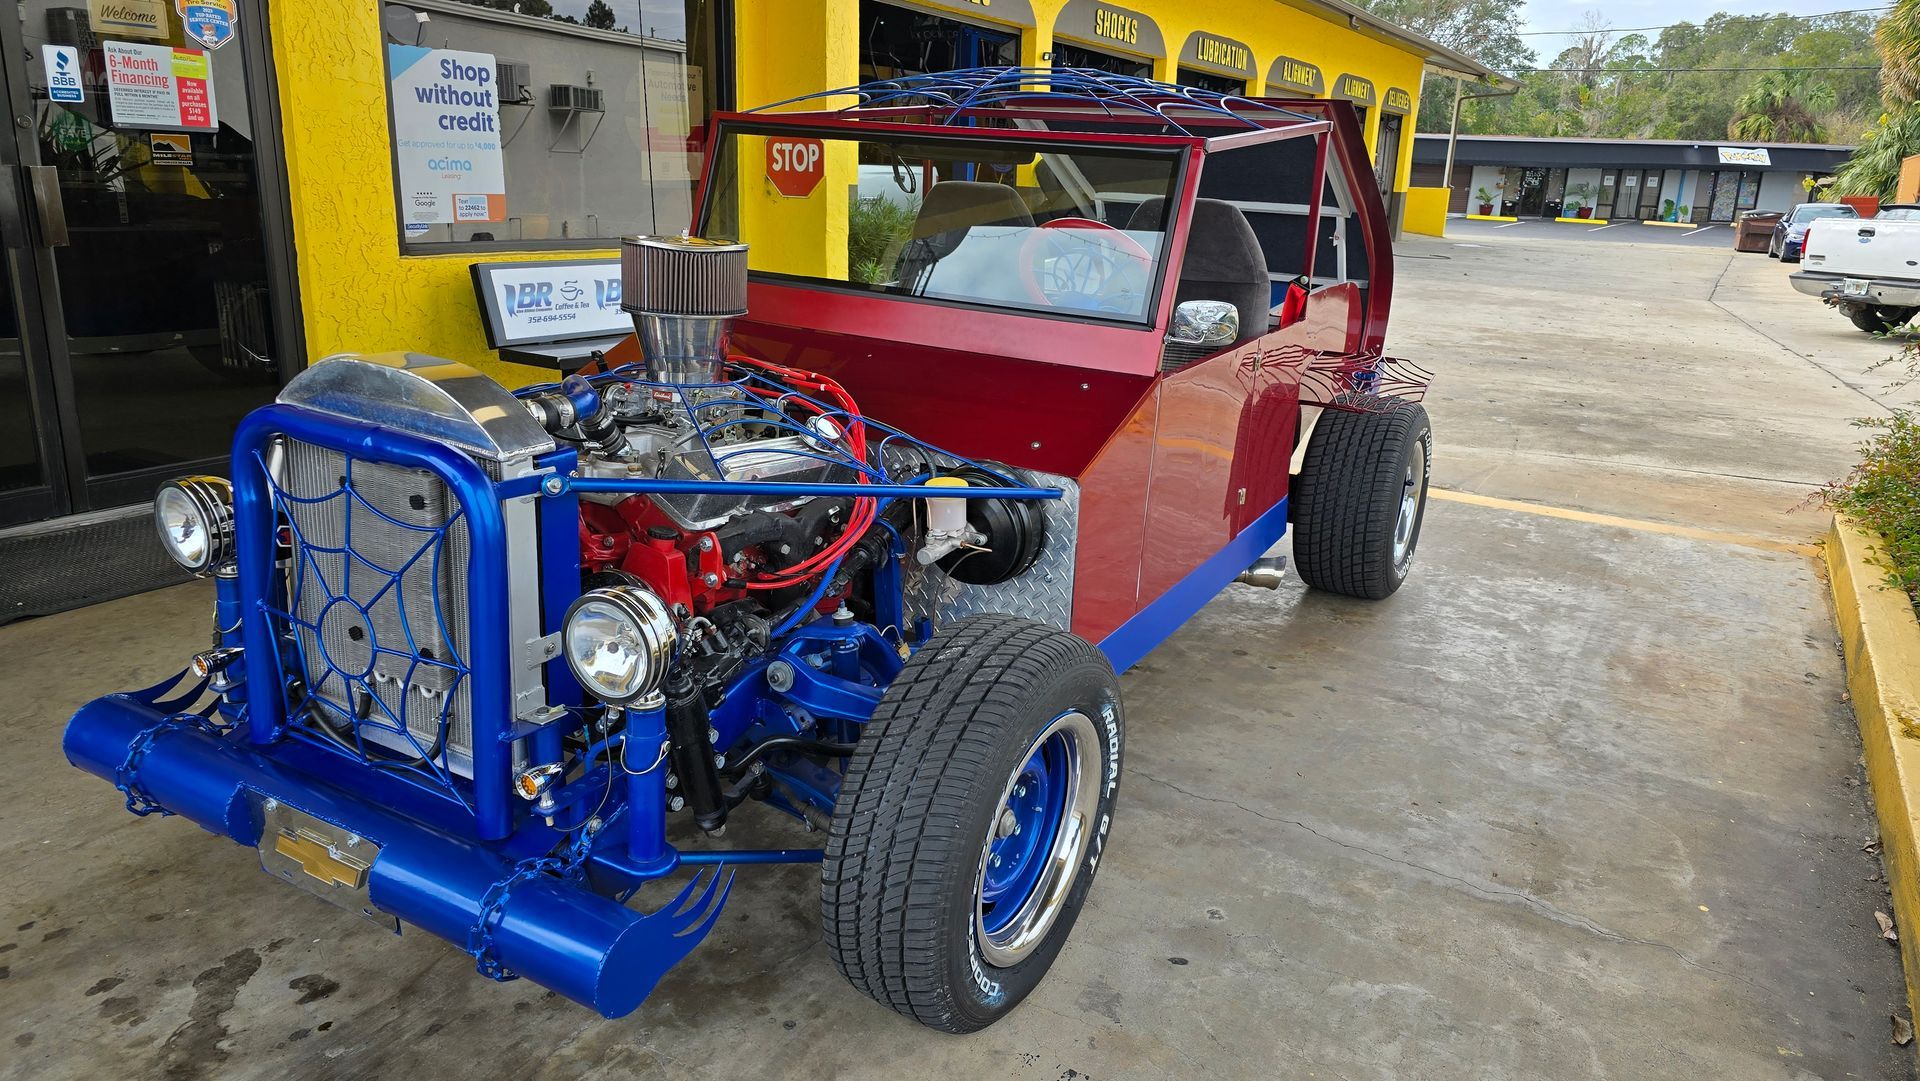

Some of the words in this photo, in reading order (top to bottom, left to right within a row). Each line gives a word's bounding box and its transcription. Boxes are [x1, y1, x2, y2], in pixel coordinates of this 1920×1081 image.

[100, 5, 157, 23] Welcome
[1095, 8, 1138, 45] SHOCKS
[109, 54, 158, 71] 6-Month
[1197, 36, 1248, 71] LUBRICATION
[52, 76, 76, 86] BBB
[111, 69, 169, 89] Financing
[440, 58, 491, 87] Shop
[1282, 61, 1317, 88] ALIGNMENT
[414, 83, 493, 108] without
[1344, 78, 1370, 100] ALIGNMENT
[1387, 89, 1409, 110] DELIVERIES
[439, 111, 495, 133] credit
[398, 138, 410, 147] Get
[411, 138, 445, 151] approved
[446, 139, 456, 149] for
[456, 141, 466, 150] up
[466, 141, 475, 149] to
[427, 156, 473, 172] acima
[772, 142, 819, 172] STOP
[414, 199, 437, 208] Google
[555, 303, 574, 311] Coffee
[528, 313, 576, 324] 352-694-5554
[1102, 707, 1119, 799] RADIAL
